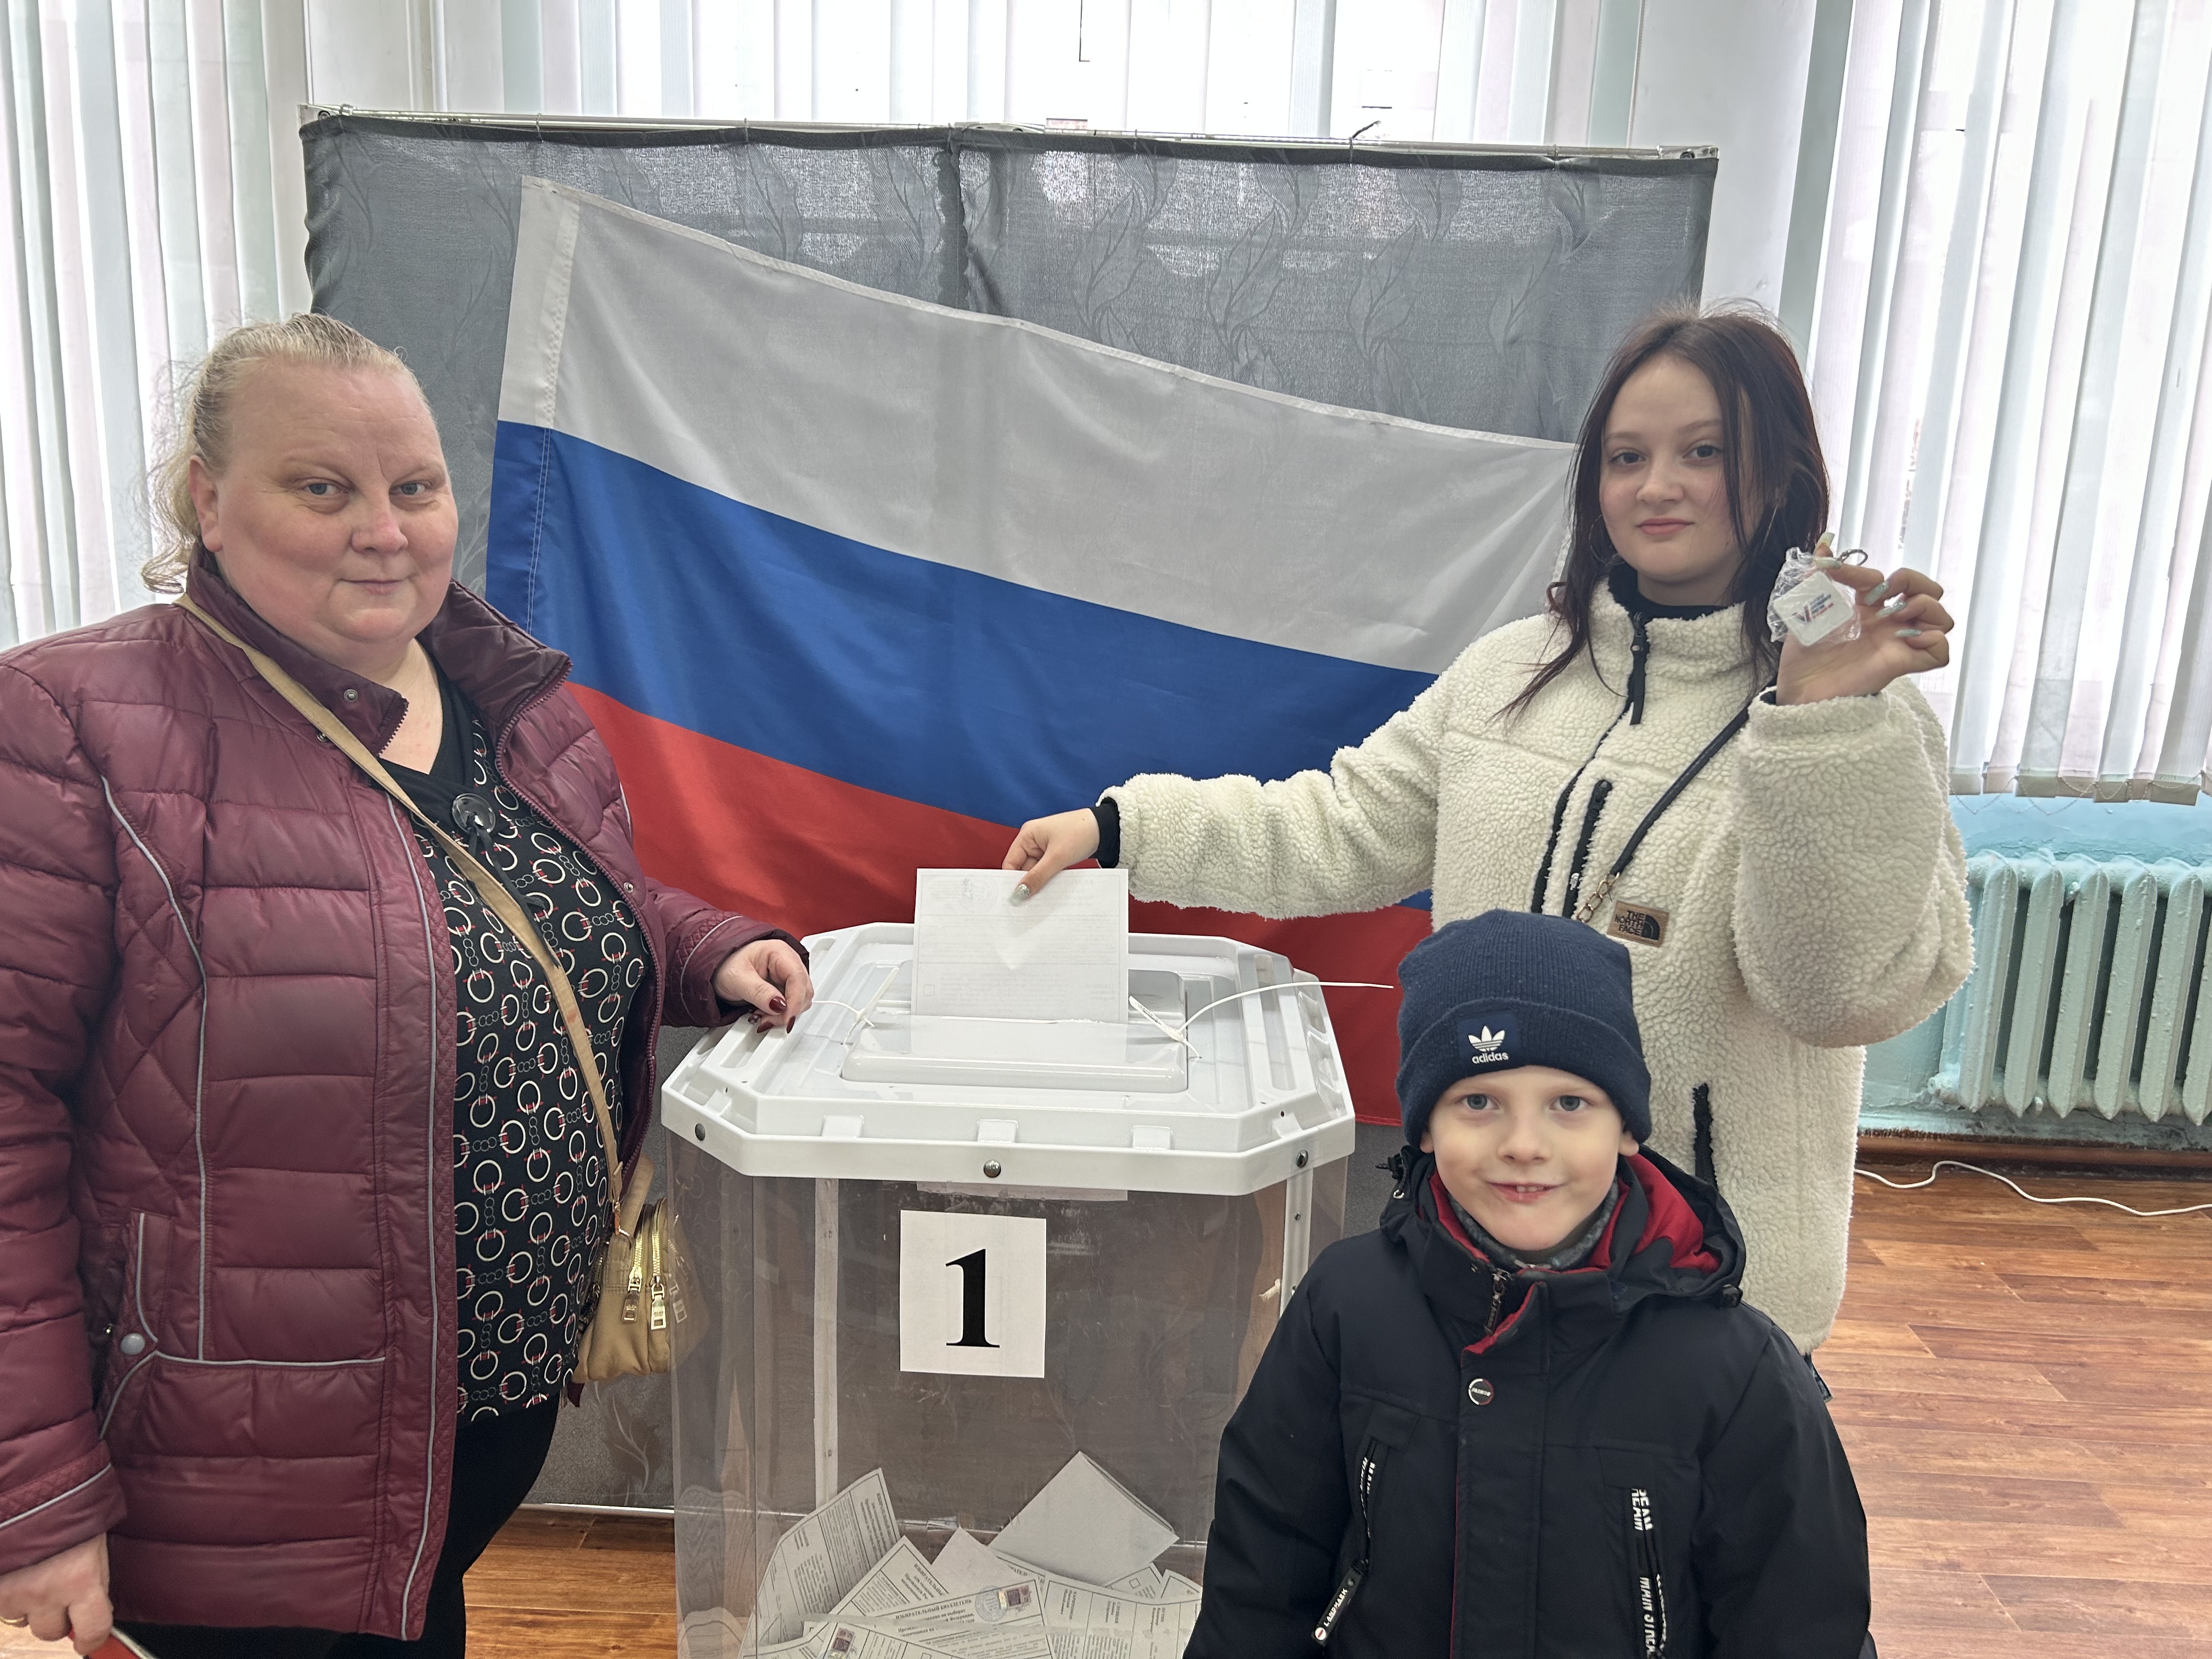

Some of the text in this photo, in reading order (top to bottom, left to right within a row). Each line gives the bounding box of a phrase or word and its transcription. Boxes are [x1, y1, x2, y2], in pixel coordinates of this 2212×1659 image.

[1615, 914, 1644, 928] NORTH
[1627, 911, 1645, 921] THE
[1618, 924, 1641, 936] FACE
[1471, 1052, 1509, 1064] adidas
[945, 1249, 1000, 1348] 1
